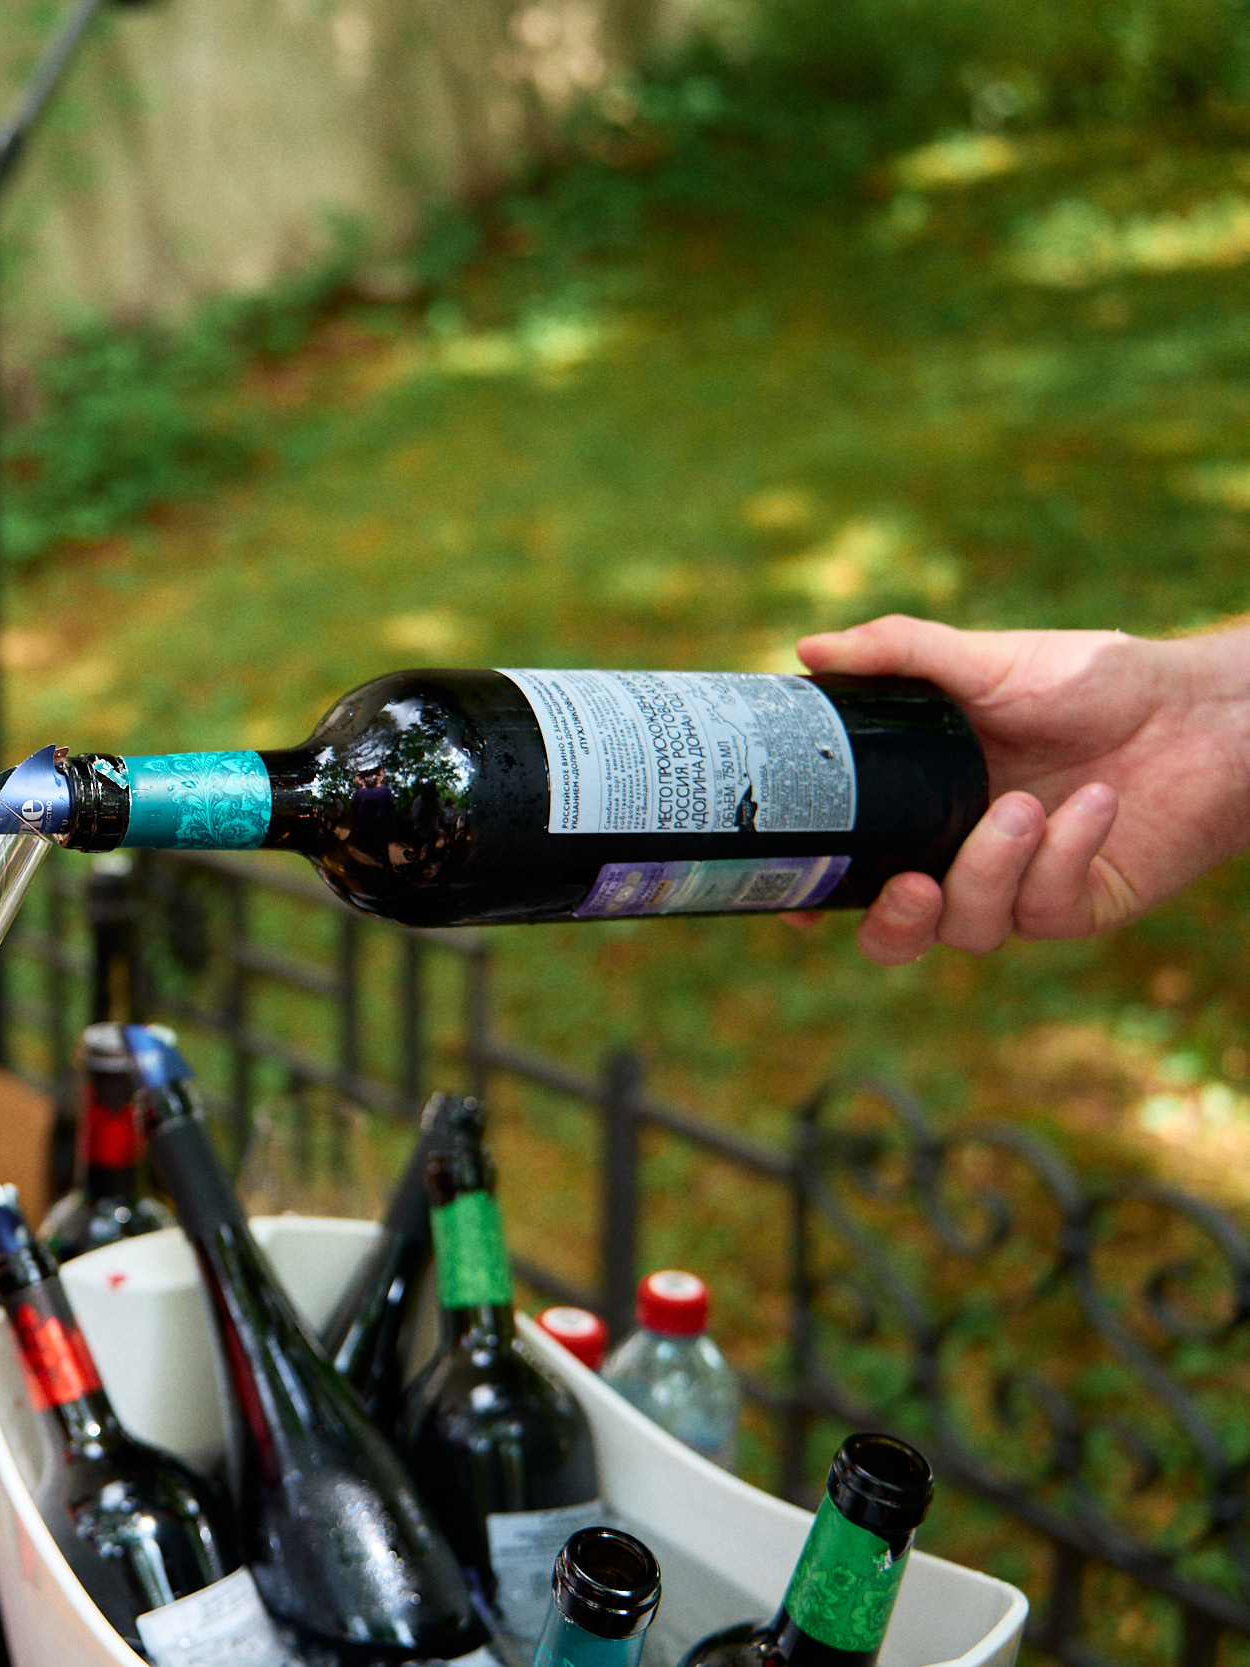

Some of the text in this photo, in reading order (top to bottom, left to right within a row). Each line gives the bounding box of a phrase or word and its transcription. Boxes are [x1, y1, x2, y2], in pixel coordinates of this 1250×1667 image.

[663, 692, 689, 712] ГОД
[558, 742, 568, 766] ВИНО
[677, 714, 706, 758] ДОНА»
[561, 770, 570, 828] РОССИЙСКОЕ
[571, 781, 579, 829] УКАЗАНИЕМ
[657, 786, 672, 829] МЕСТО
[673, 763, 690, 828] РОССИЯ,
[690, 760, 709, 829] «ДОЛИНА
[716, 740, 735, 828] ОБЪЕМ: 750 МЛ
